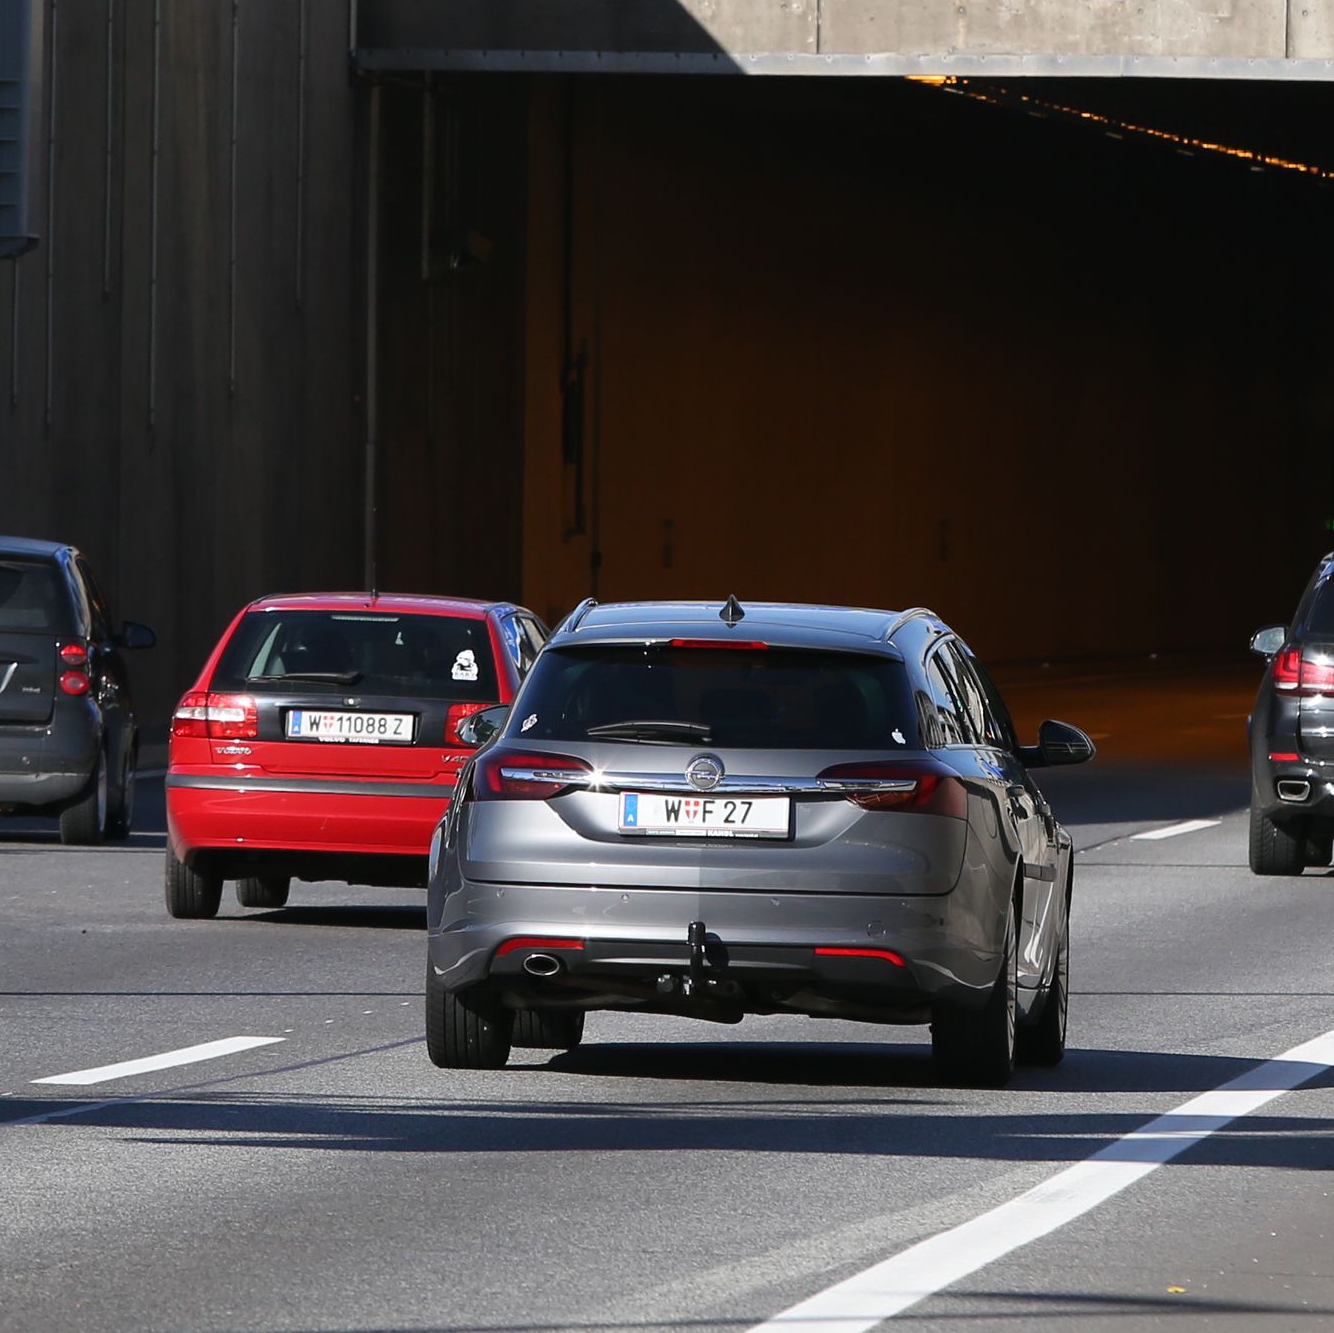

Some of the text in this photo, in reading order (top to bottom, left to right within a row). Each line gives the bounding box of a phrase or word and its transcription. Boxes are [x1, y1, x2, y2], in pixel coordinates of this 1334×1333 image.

[309, 715, 321, 731] W
[336, 716, 387, 734] 11088
[665, 799, 753, 824] W F 27
